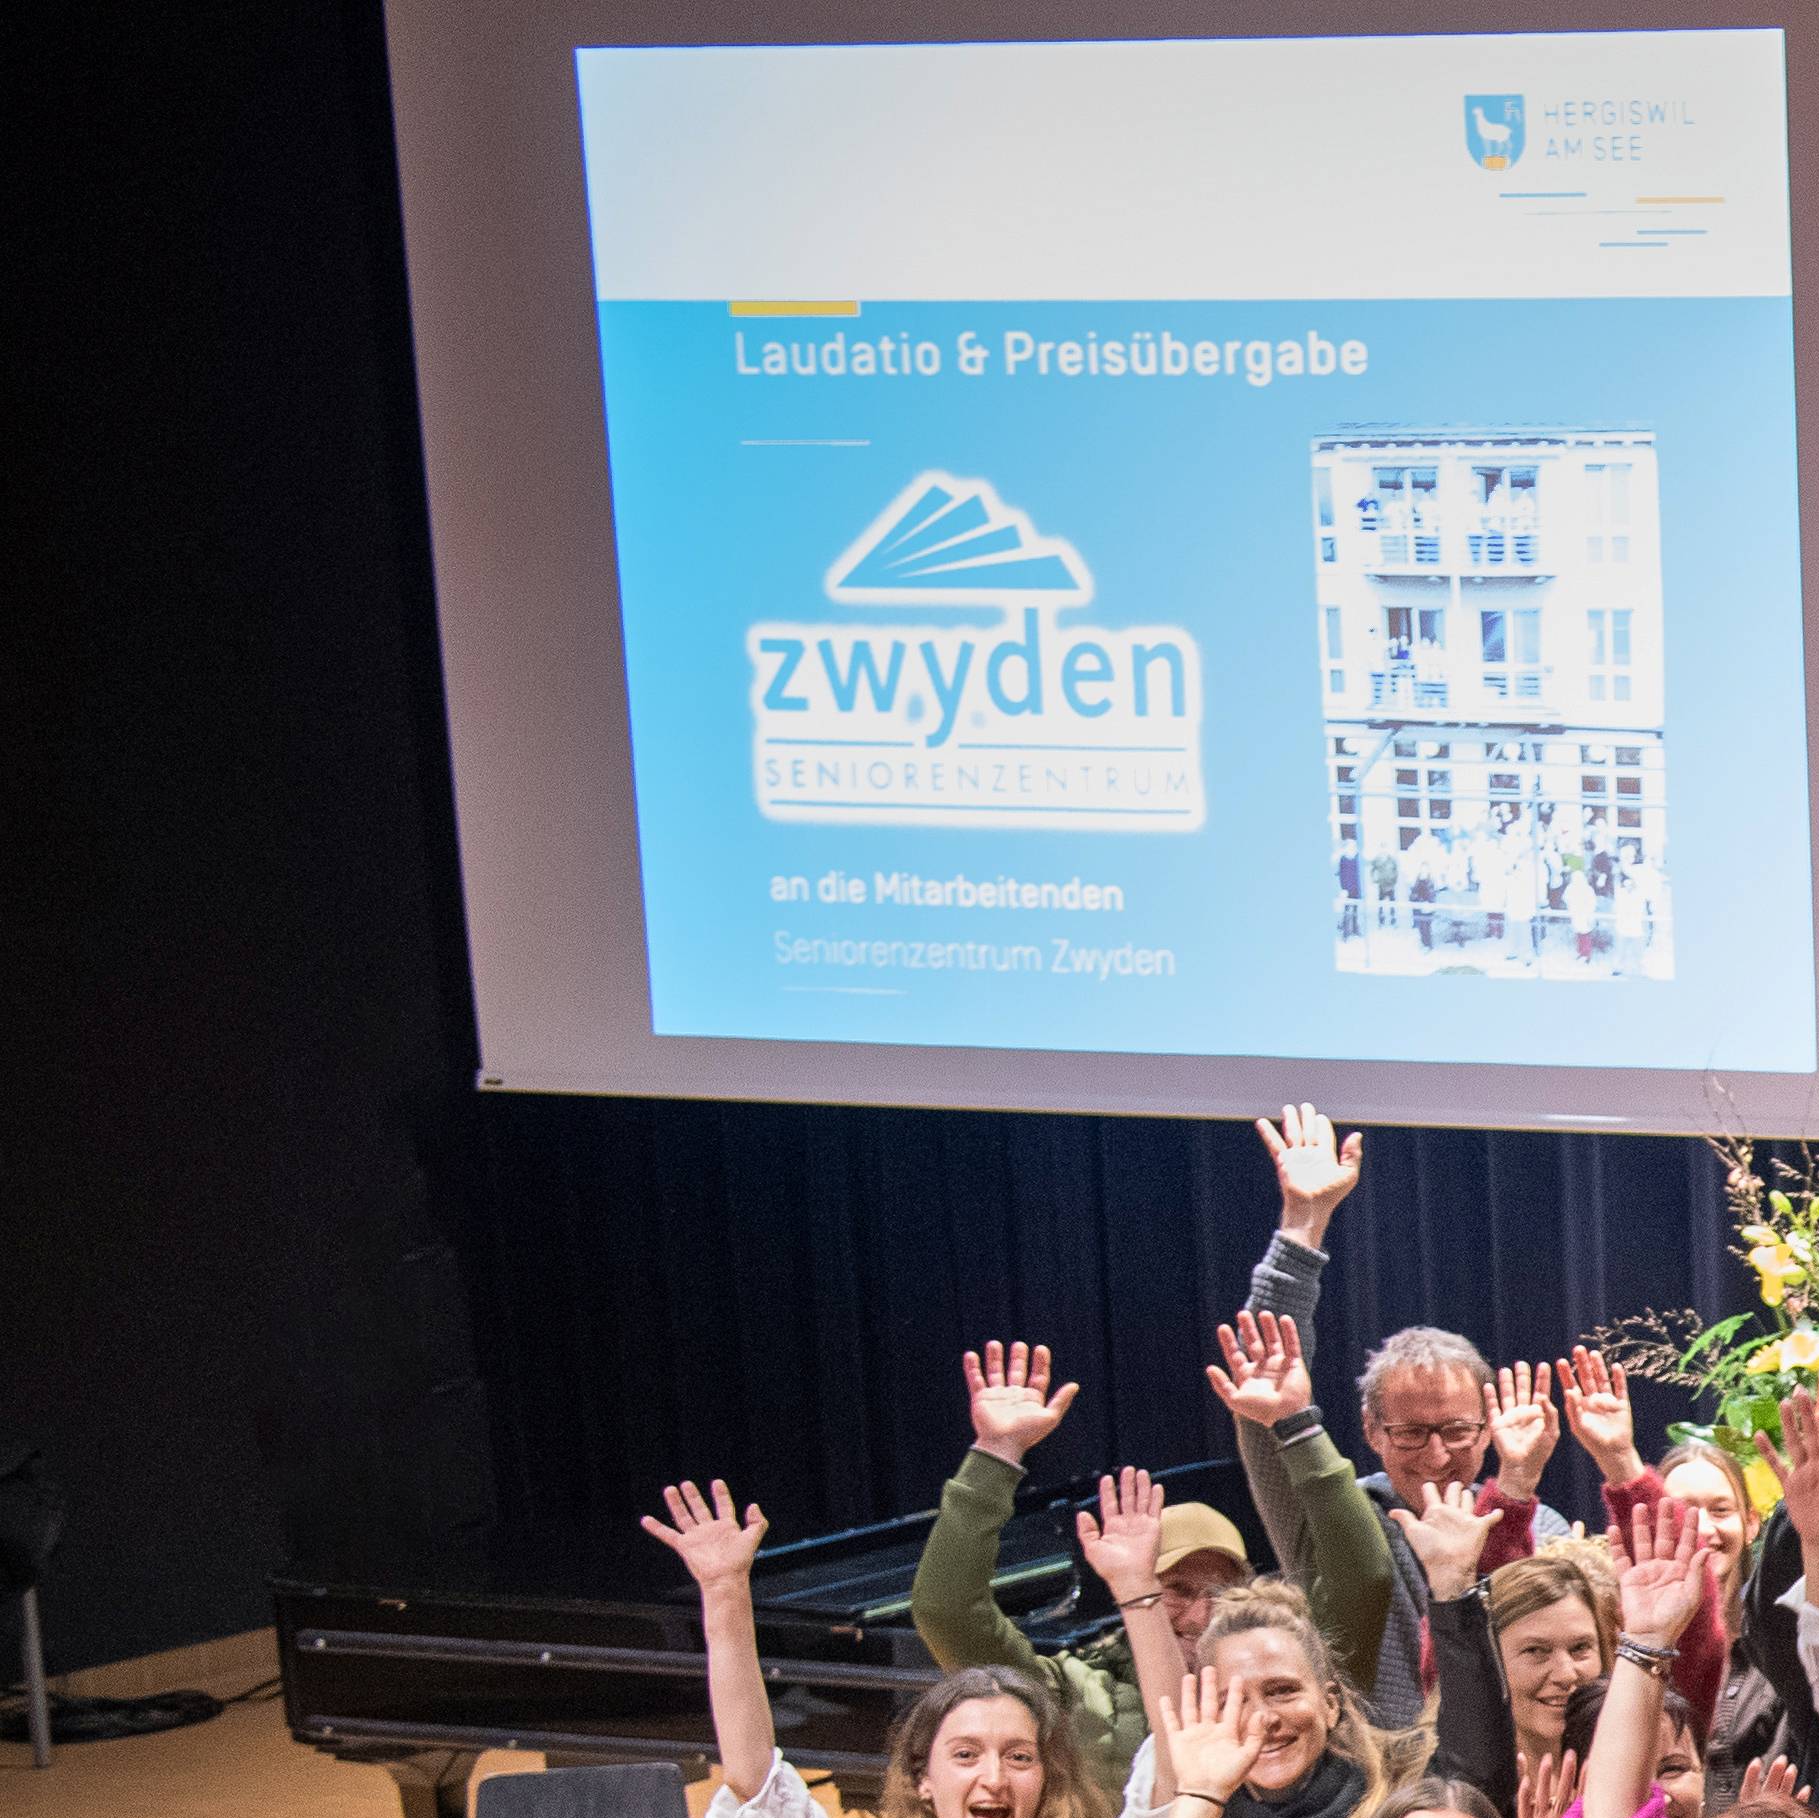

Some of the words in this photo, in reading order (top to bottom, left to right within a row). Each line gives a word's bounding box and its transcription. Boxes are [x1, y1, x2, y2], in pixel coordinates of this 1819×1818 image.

[1543, 99, 1696, 127] HERGISWIL
[1544, 136, 1583, 161] AM
[1592, 136, 1645, 161] SEE
[734, 330, 943, 376] Laudatio
[956, 330, 991, 376] &
[1003, 330, 1369, 388] Preisübergabe
[759, 606, 1187, 749] zwyden
[764, 757, 1191, 796] SENIORENZENTRUM
[769, 874, 810, 903] an
[817, 869, 867, 904] die
[873, 870, 1125, 912] Mitarbeitenden
[773, 929, 1043, 972] Seniorenzentrum
[1049, 937, 1177, 983] Zwyden
